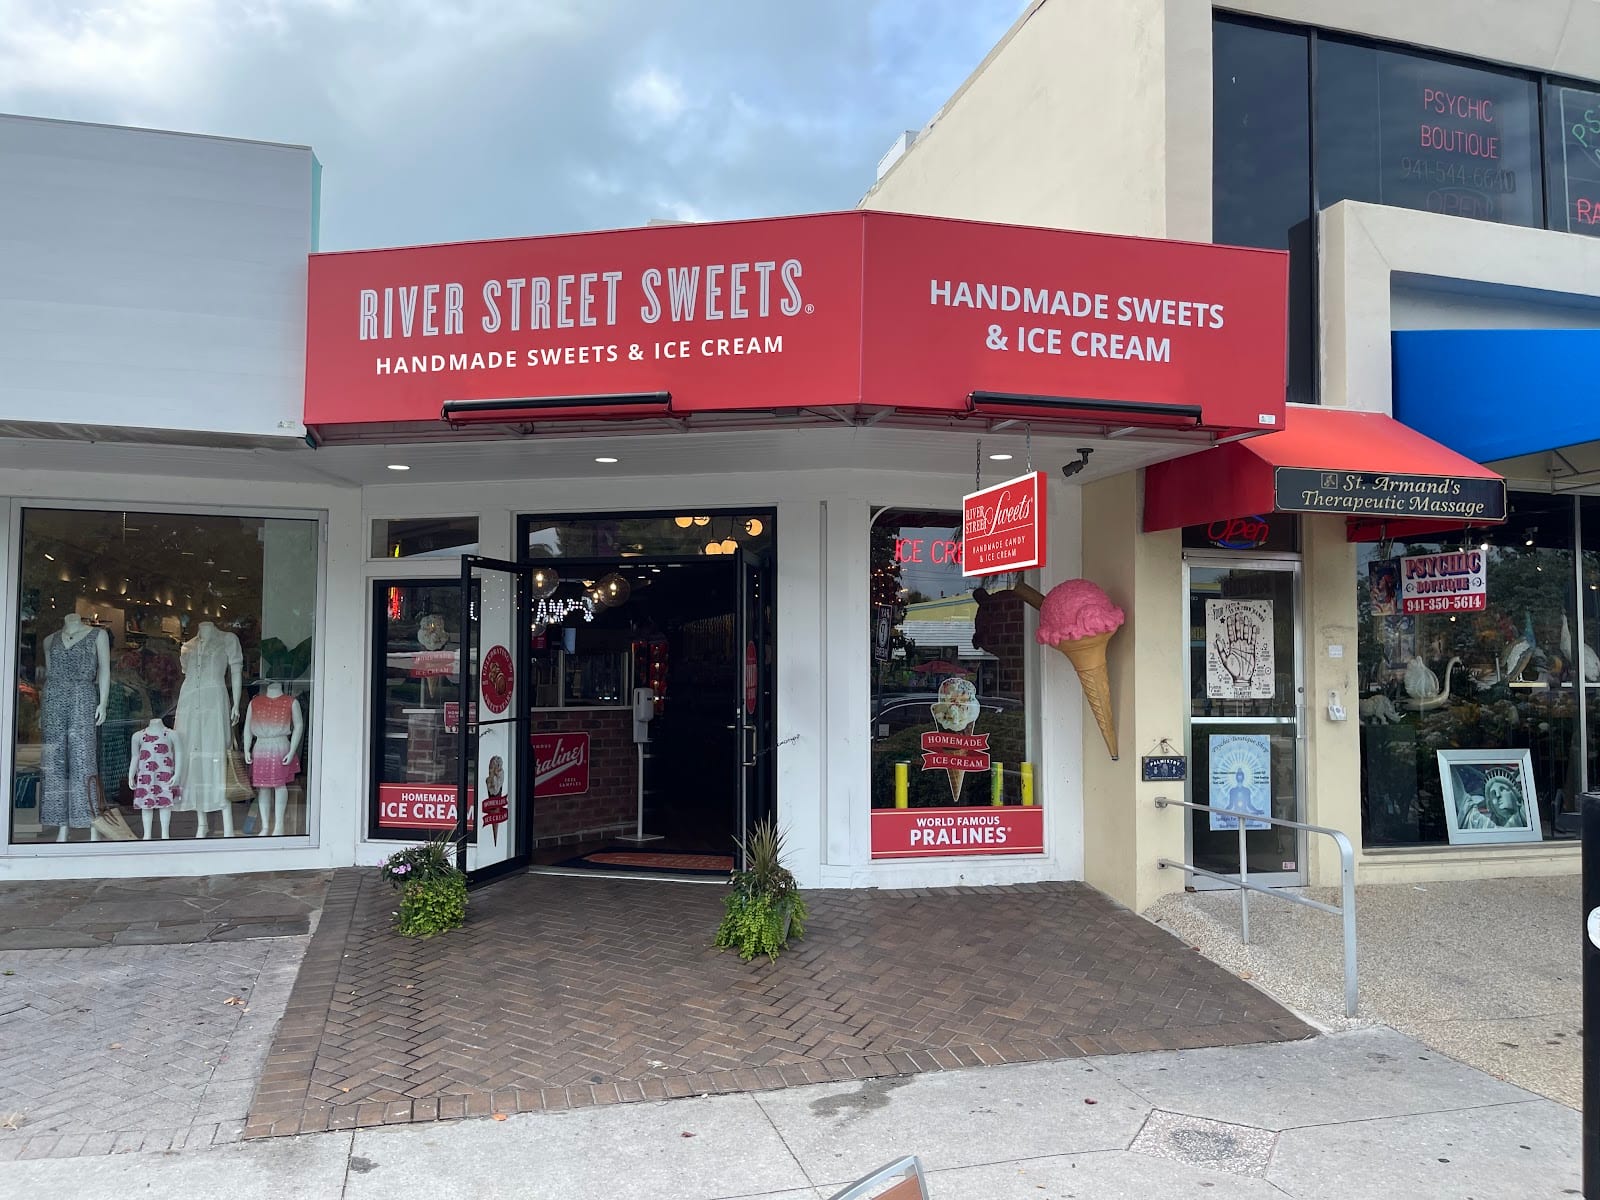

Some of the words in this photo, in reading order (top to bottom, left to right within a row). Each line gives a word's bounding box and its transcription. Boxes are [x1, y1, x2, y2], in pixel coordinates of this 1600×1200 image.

[1424, 88, 1493, 122] PSYCHIC
[1421, 124, 1499, 159] BOUTIQUE
[359, 282, 464, 341] RIVER
[482, 271, 623, 335] STREET
[930, 279, 1109, 320] HANDMADE
[1117, 296, 1225, 329] SWEETS
[985, 324, 1009, 351] &
[1018, 326, 1062, 355] ICE
[1071, 331, 1171, 363] CREAM
[376, 350, 517, 375] HANDMADE
[526, 343, 618, 367] SWEETS
[628, 343, 645, 361] &
[654, 340, 691, 359] ICE
[701, 335, 784, 357] CREAM
[1342, 474, 1366, 492] St.
[1372, 476, 1461, 495] Armand's
[966, 505, 985, 521] RIVER
[985, 490, 1031, 536] Sweets
[1301, 490, 1405, 512] Therapeutic
[1409, 496, 1484, 517] Massage
[966, 518, 987, 534] STREET
[894, 538, 924, 564] ICE
[930, 540, 963, 565] CRE
[972, 540, 1003, 554] HANDMADE
[1005, 536, 1026, 547] CANDY
[985, 553, 995, 562] ICE
[996, 548, 1017, 560] CREAM
[1405, 552, 1482, 580] PSYCHIC
[1416, 578, 1470, 594] BOUTIQUE
[1406, 595, 1482, 612] 941-350-5614
[928, 735, 982, 747] HOMEMADE
[535, 738, 585, 775] ralines
[932, 756, 948, 765] ICE
[950, 758, 983, 768] CREAM
[401, 793, 456, 803] HOMEMADE
[381, 802, 408, 818] ICE
[916, 817, 955, 827] WORLD
[957, 816, 1000, 826] FAMOUS
[910, 826, 1007, 846] PRALINES
